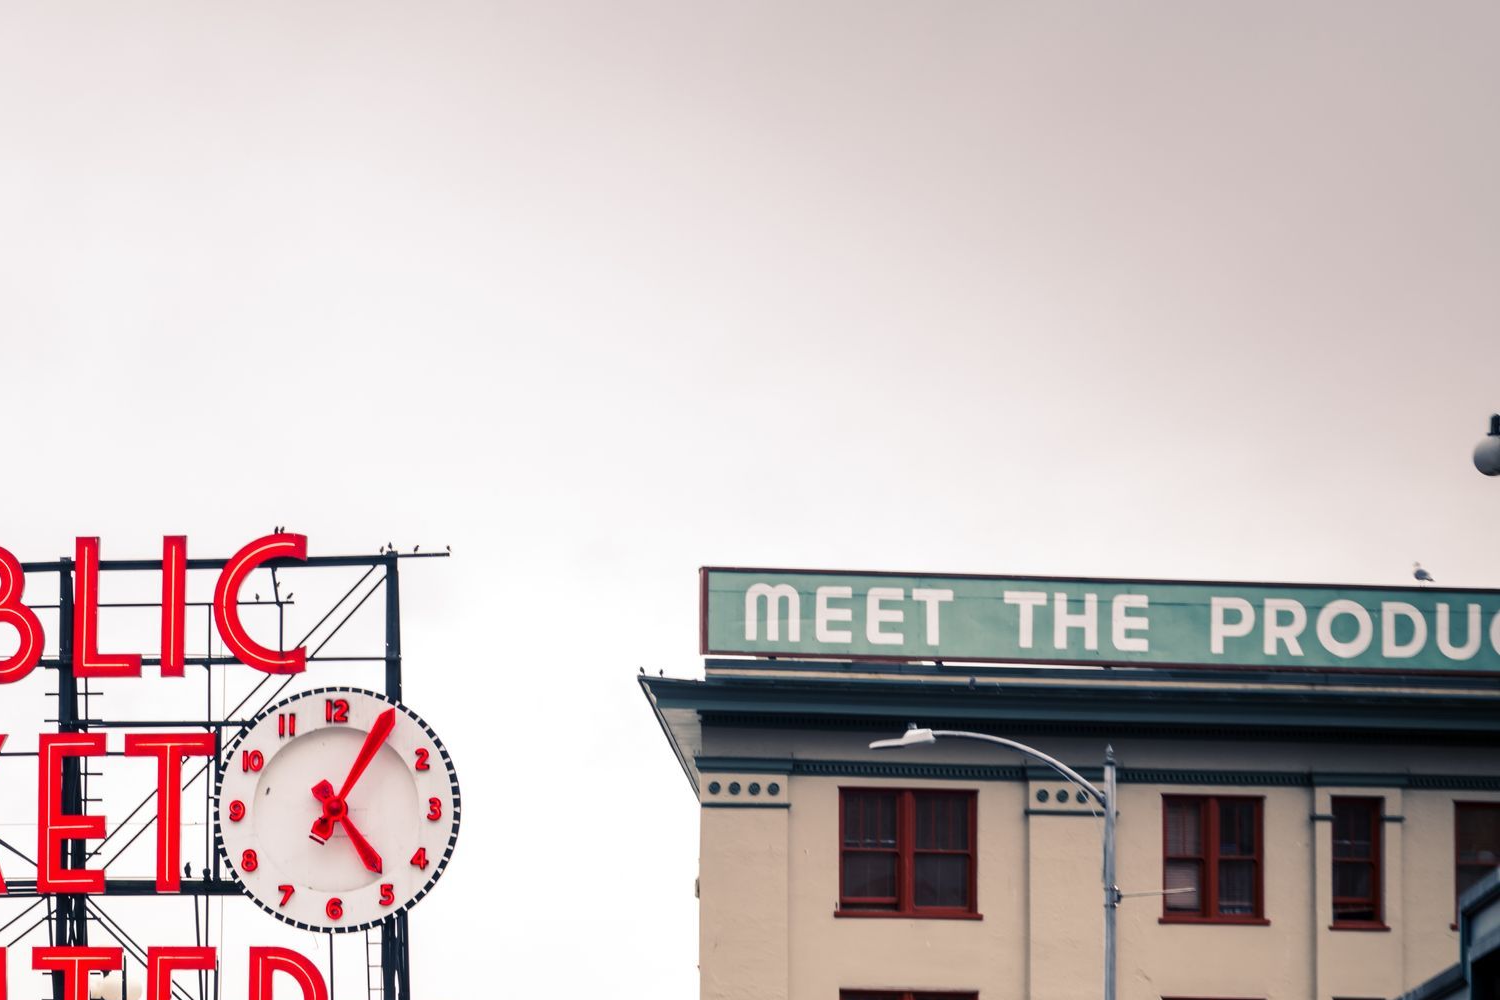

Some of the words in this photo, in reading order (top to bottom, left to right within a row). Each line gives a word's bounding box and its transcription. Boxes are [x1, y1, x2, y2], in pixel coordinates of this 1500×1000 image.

[744, 583, 955, 646] MEET
[1004, 590, 1149, 652] THE
[325, 699, 350, 724] 12
[278, 713, 297, 738] 11
[242, 750, 264, 773] 10
[414, 748, 430, 771] 2
[228, 800, 247, 823] 9
[426, 797, 443, 822] 3
[240, 849, 259, 873] 8
[410, 847, 430, 871] 4
[277, 884, 295, 908] 7
[379, 883, 395, 907] 5
[325, 897, 344, 921] 6
